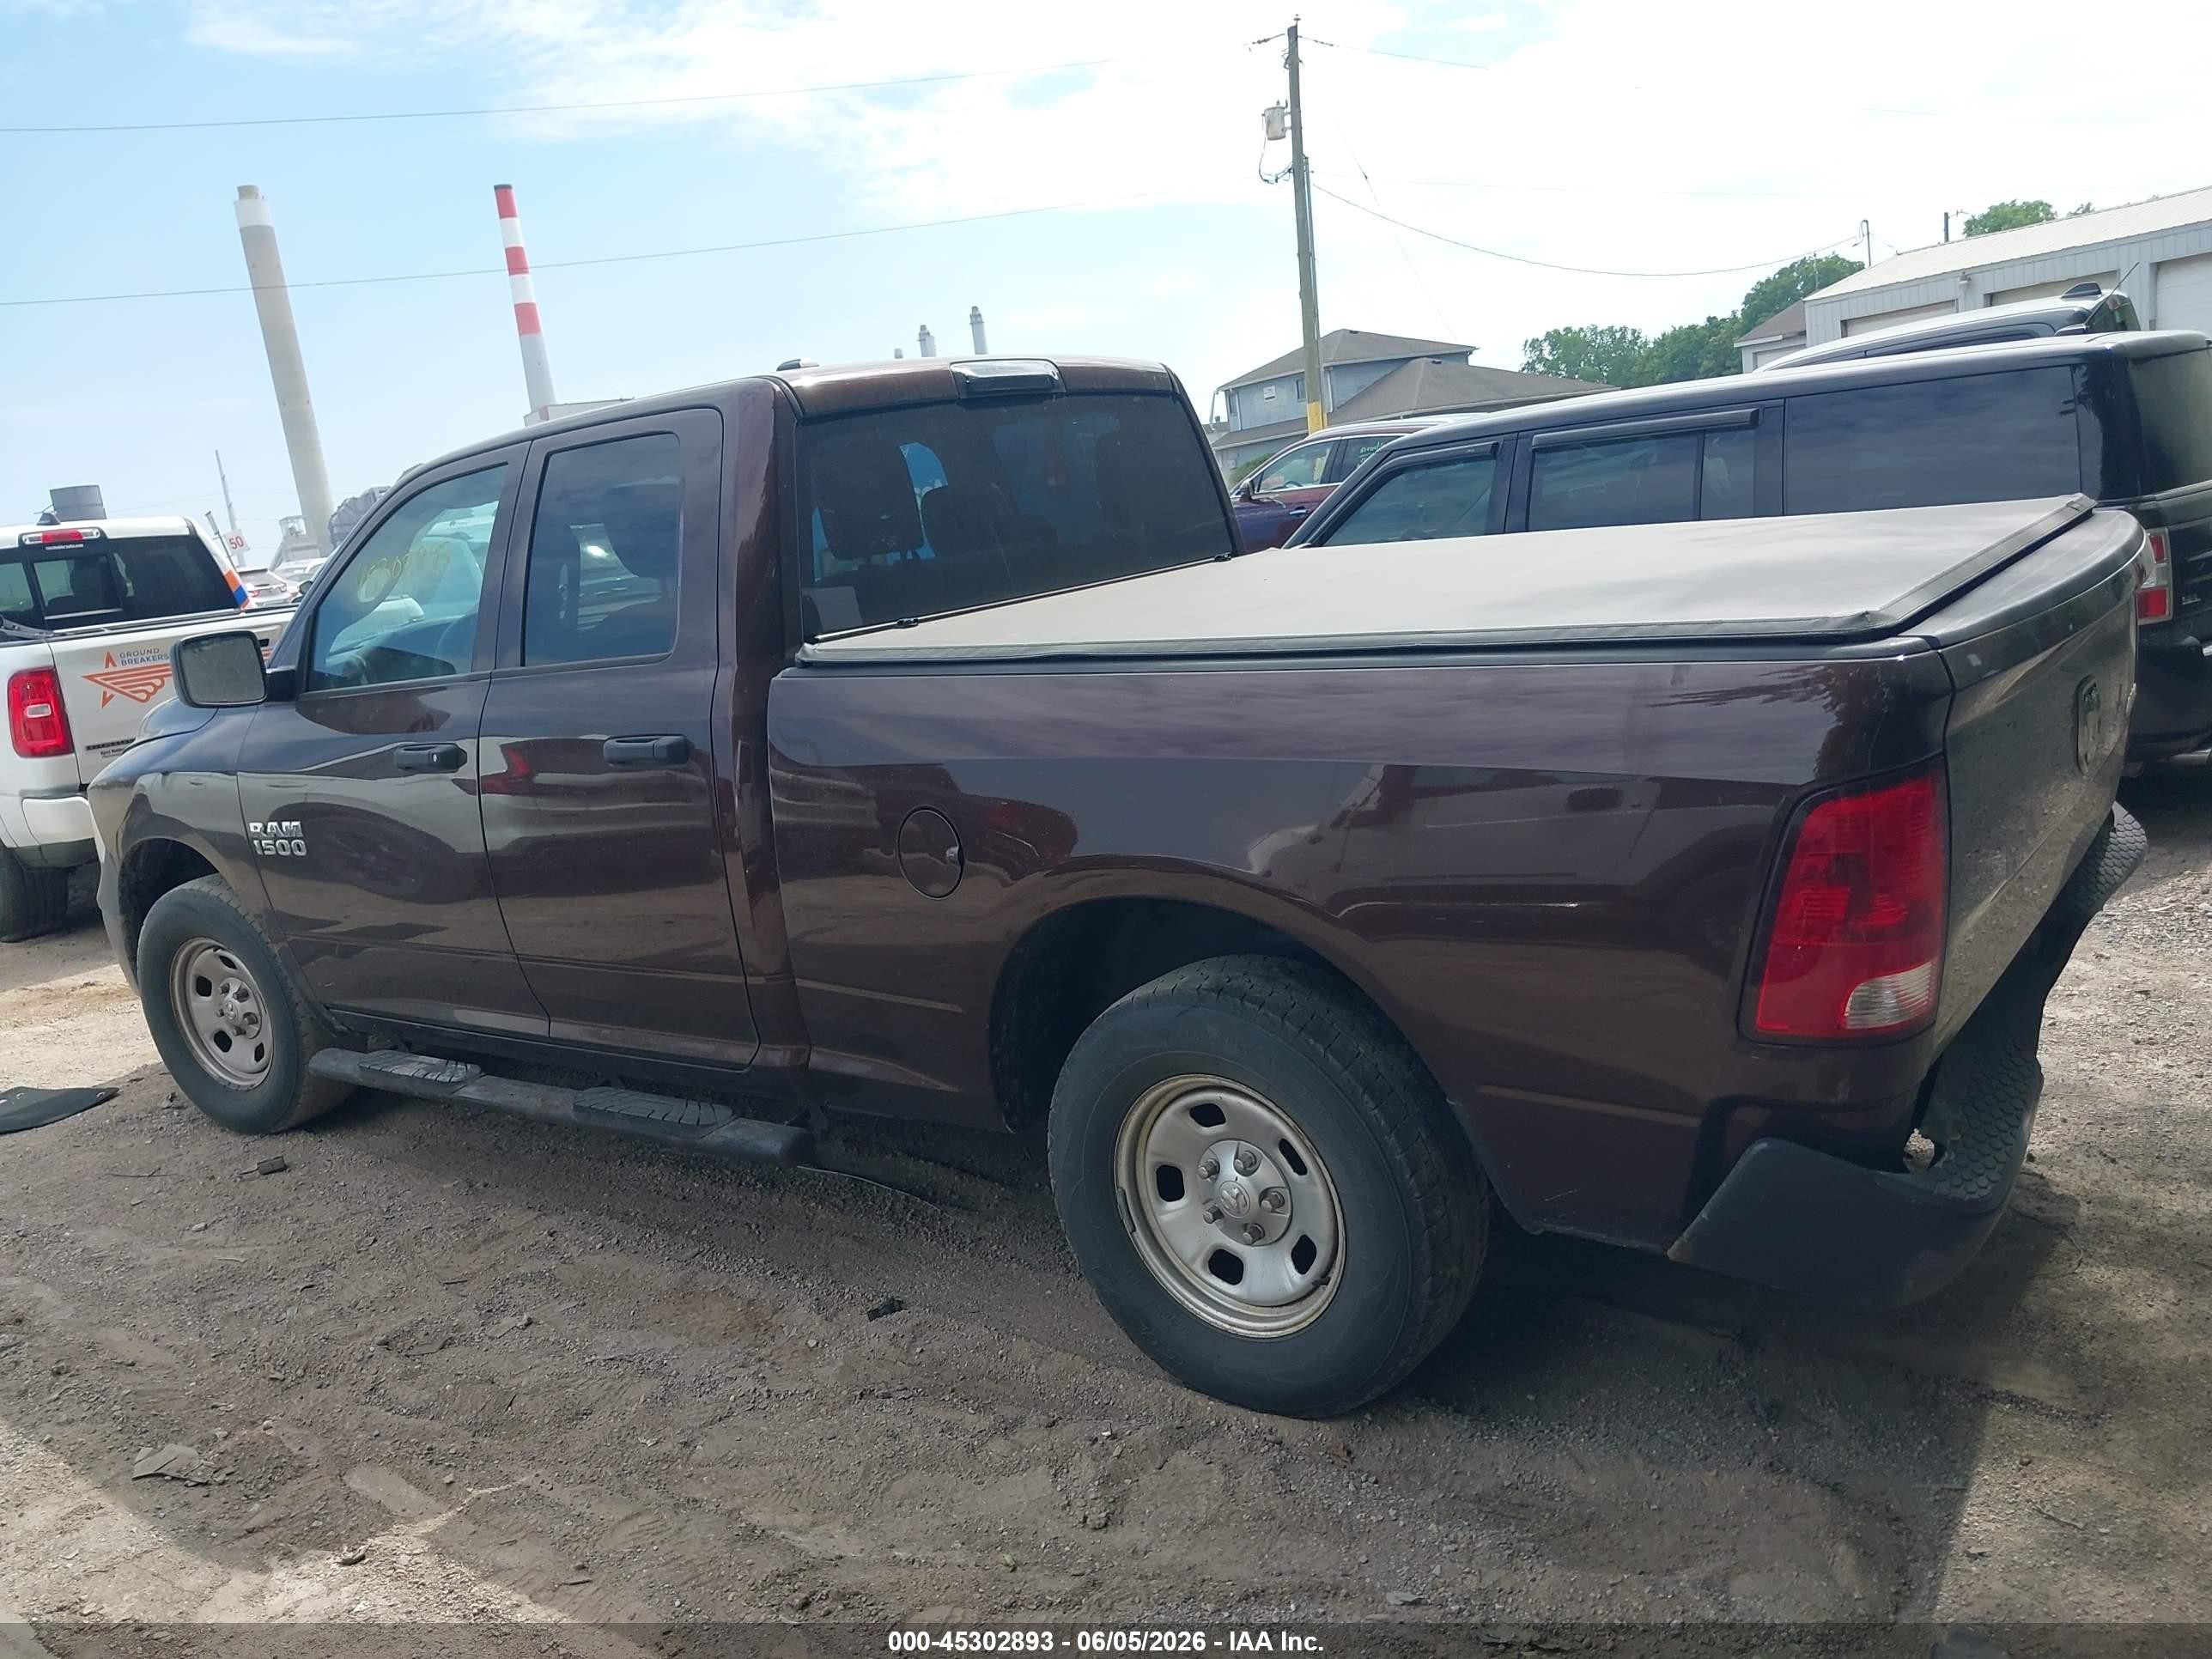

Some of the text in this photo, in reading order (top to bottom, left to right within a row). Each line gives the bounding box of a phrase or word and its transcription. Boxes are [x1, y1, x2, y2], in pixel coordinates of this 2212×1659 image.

[228, 536, 244, 550] 50
[119, 647, 160, 659] GROUND
[120, 653, 169, 666] BREAKERS
[249, 821, 304, 837] RAM
[253, 839, 307, 856] 1500
